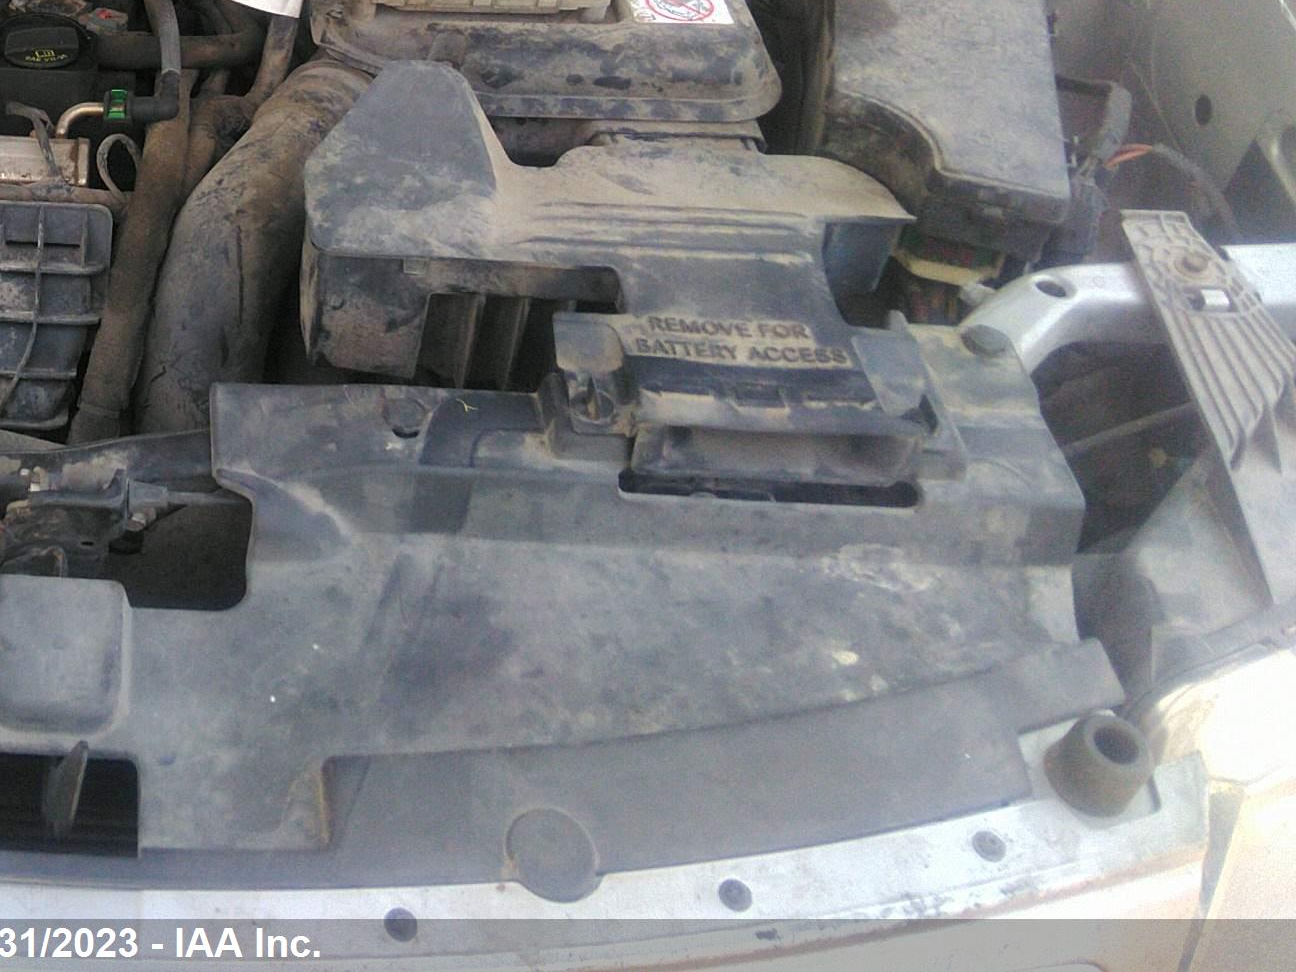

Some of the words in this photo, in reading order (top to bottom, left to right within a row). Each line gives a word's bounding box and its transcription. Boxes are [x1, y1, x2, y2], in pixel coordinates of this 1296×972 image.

[647, 315, 753, 338] REMOVE
[759, 322, 811, 339] FOR
[634, 337, 737, 360] BATTERY
[747, 346, 849, 364] ACCESS
